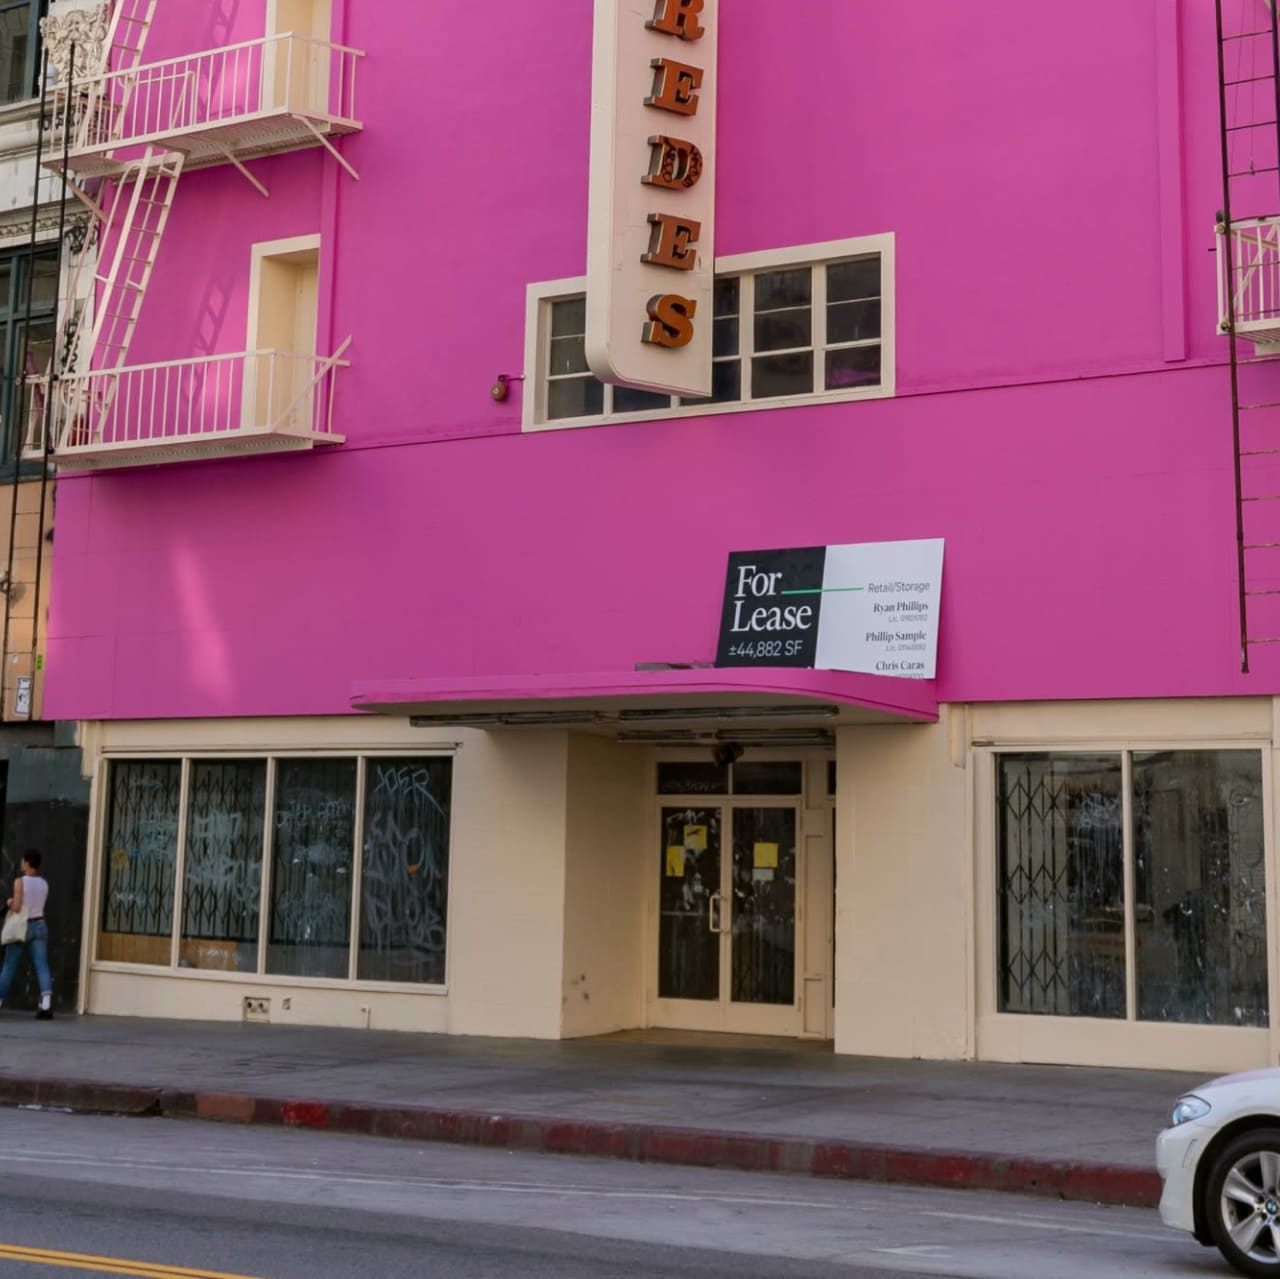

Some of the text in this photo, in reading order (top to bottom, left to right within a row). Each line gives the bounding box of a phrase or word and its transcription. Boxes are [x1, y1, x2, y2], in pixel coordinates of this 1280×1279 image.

[734, 565, 782, 598] For
[868, 581, 930, 594] Retail/Storage
[873, 601, 929, 615] Ryan Phillips
[730, 600, 812, 633] Lease
[865, 629, 927, 644] Phillip Sample
[728, 639, 803, 659] ±44,882 SF
[875, 660, 899, 671] Chris
